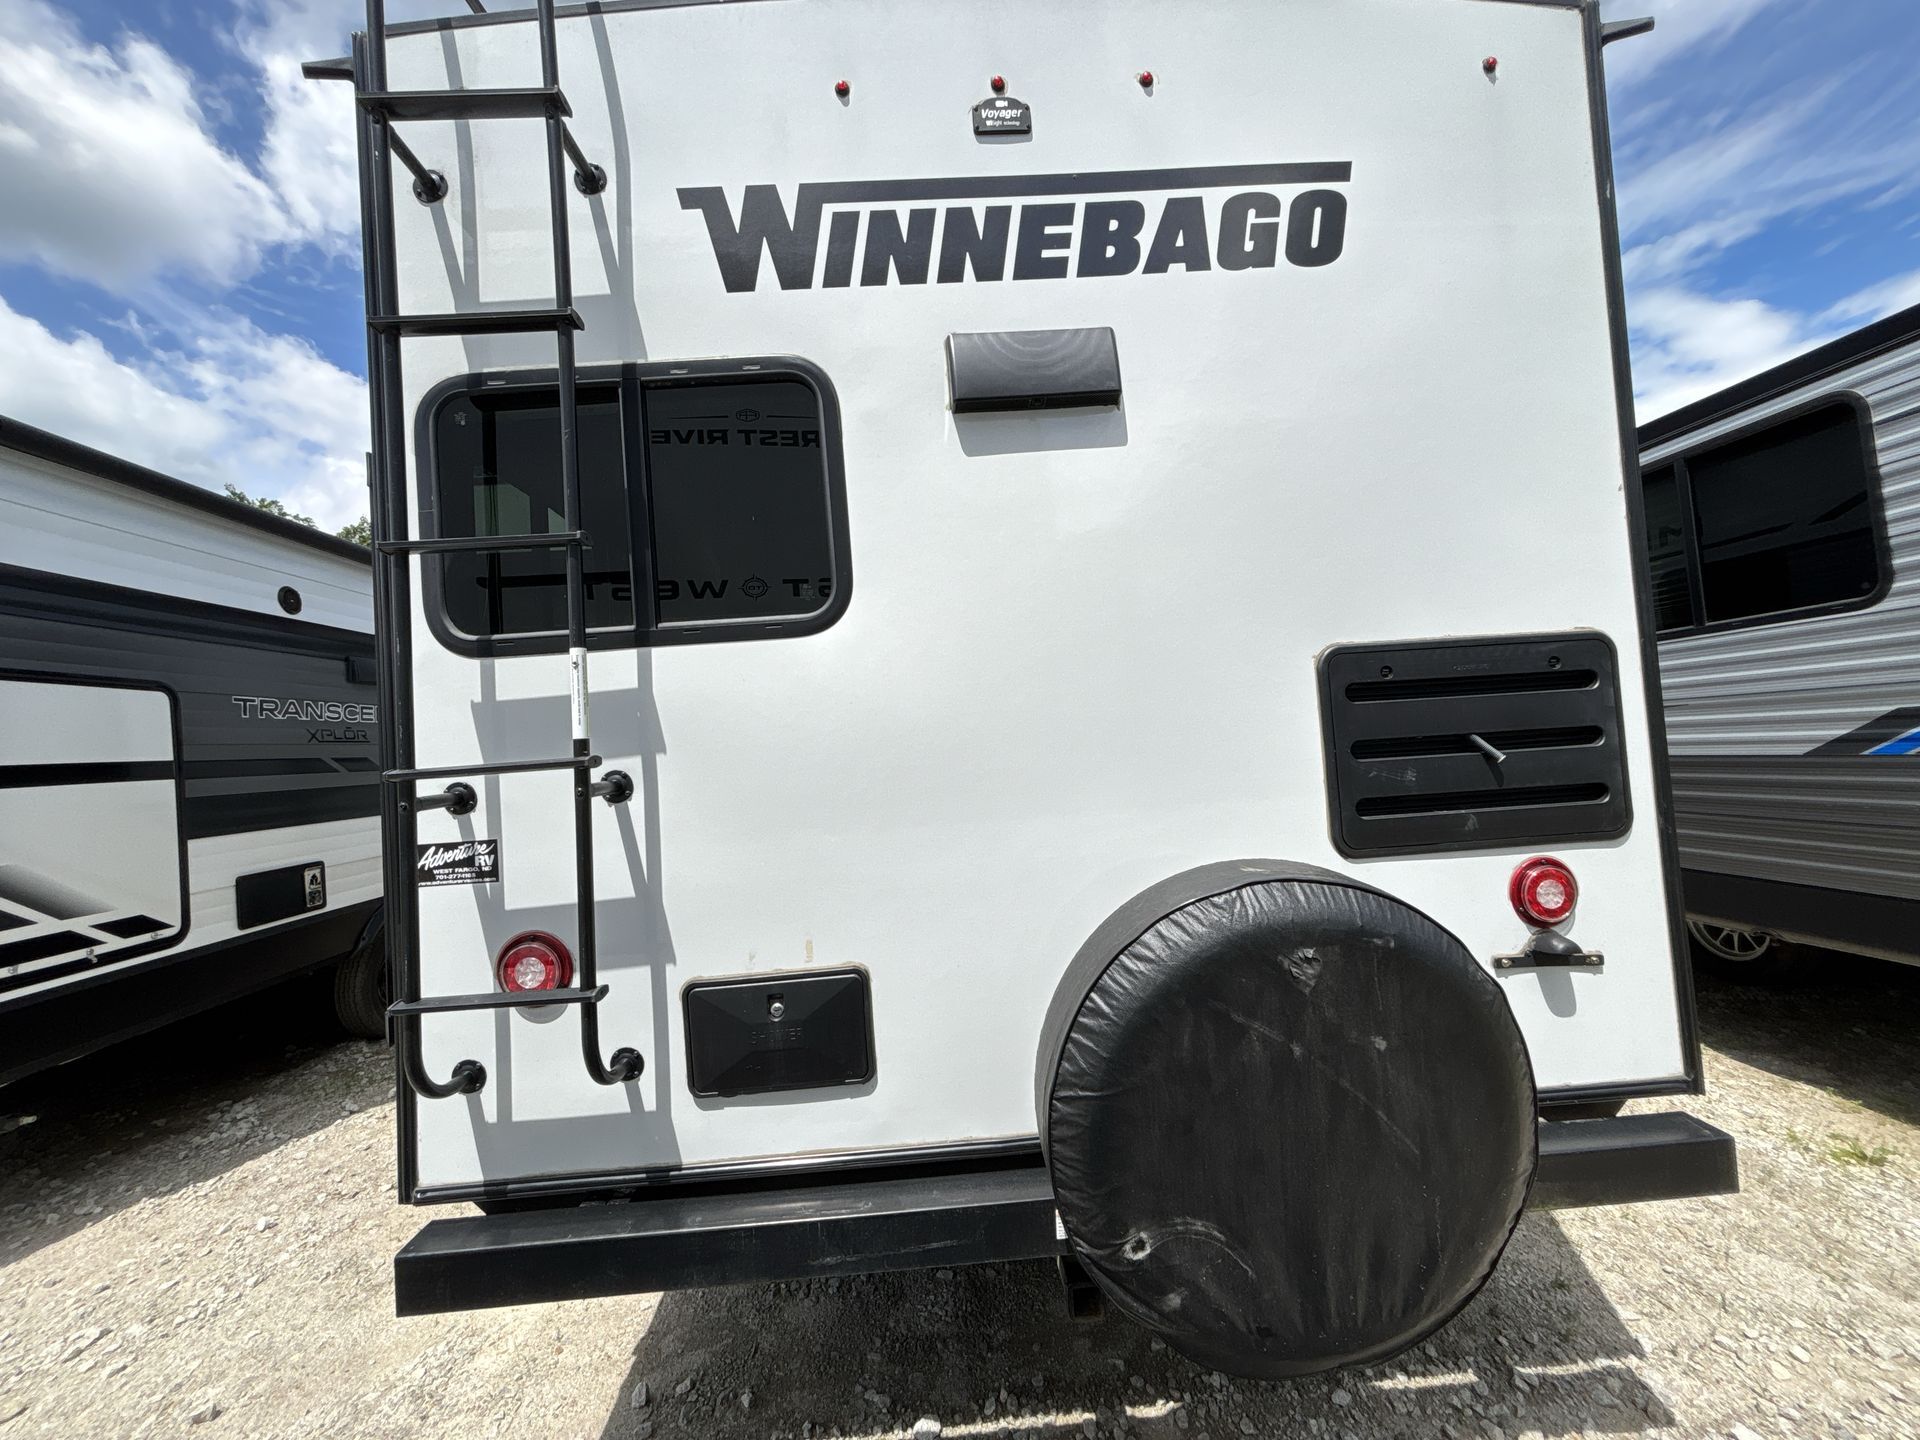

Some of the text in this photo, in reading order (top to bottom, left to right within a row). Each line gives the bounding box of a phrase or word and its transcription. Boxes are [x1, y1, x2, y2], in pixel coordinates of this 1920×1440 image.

[981, 109, 1022, 119] Voyager
[676, 161, 1353, 292] WINNEBAGO
[232, 695, 379, 724] TRANSCE
[417, 841, 495, 871] Adventure
[474, 854, 495, 867] RV
